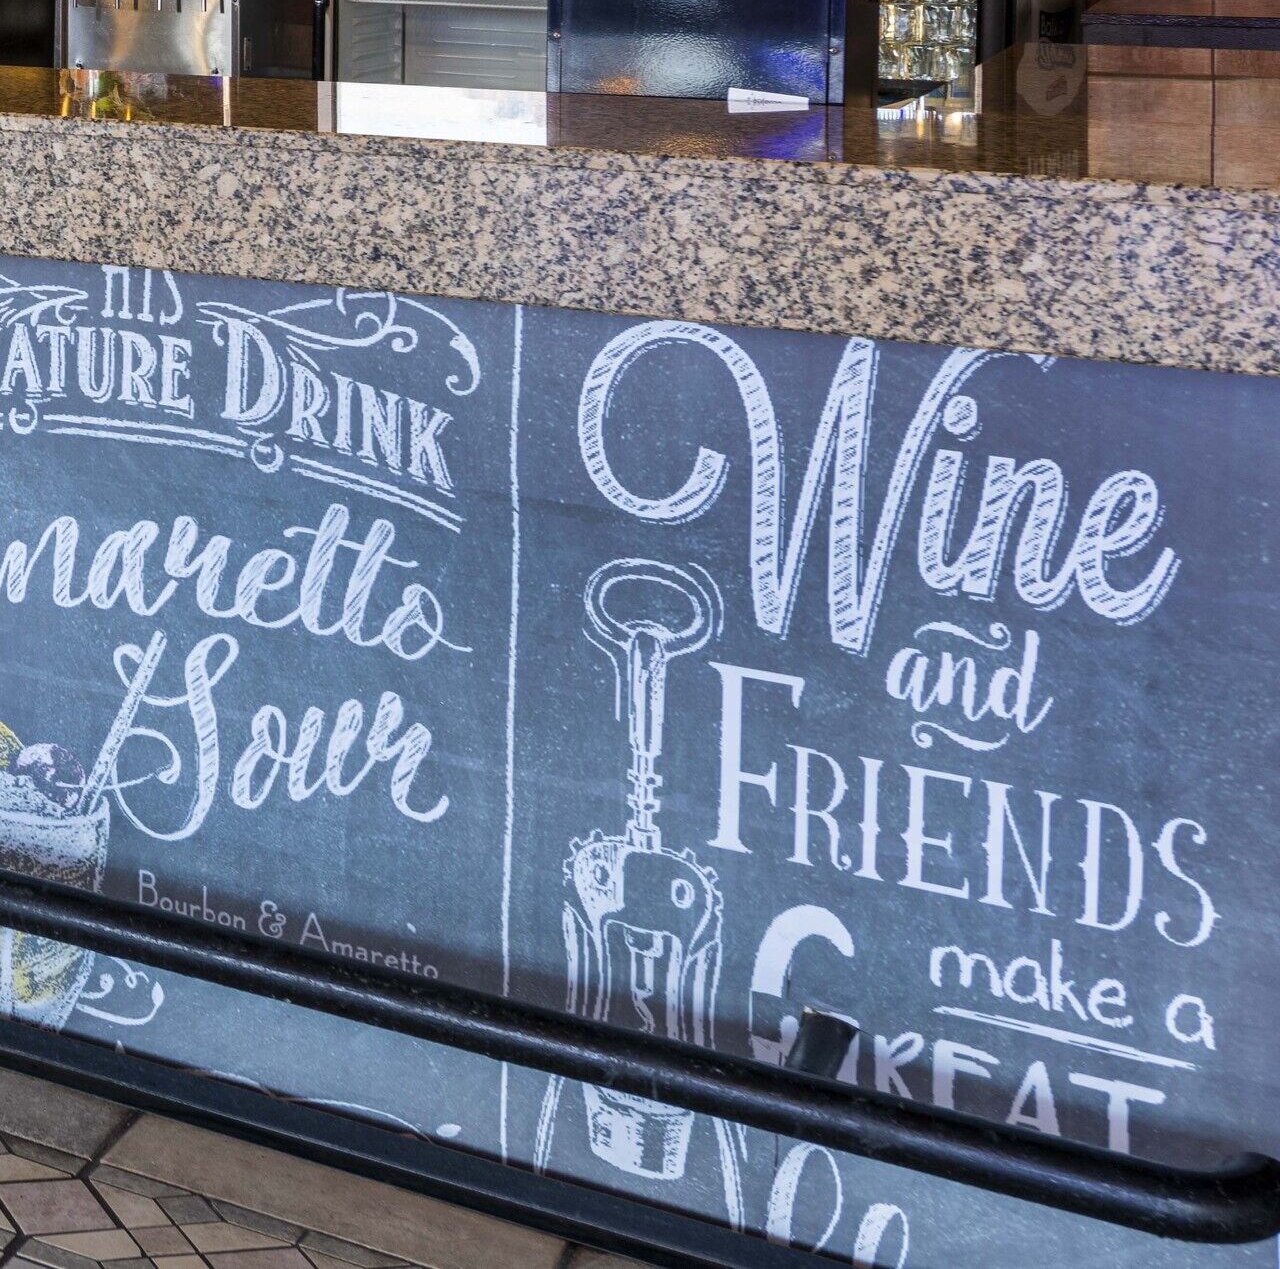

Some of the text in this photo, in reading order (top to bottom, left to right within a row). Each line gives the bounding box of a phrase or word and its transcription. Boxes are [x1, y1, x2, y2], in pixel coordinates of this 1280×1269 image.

[220, 318, 455, 496] DRINK
[578, 320, 1182, 658] Wine
[110, 633, 449, 843] Sour
[886, 629, 1054, 735] and
[707, 660, 1223, 951] FRIENDS
[136, 868, 440, 981] Bourbon Amaretto
[929, 938, 1217, 1050] make a
